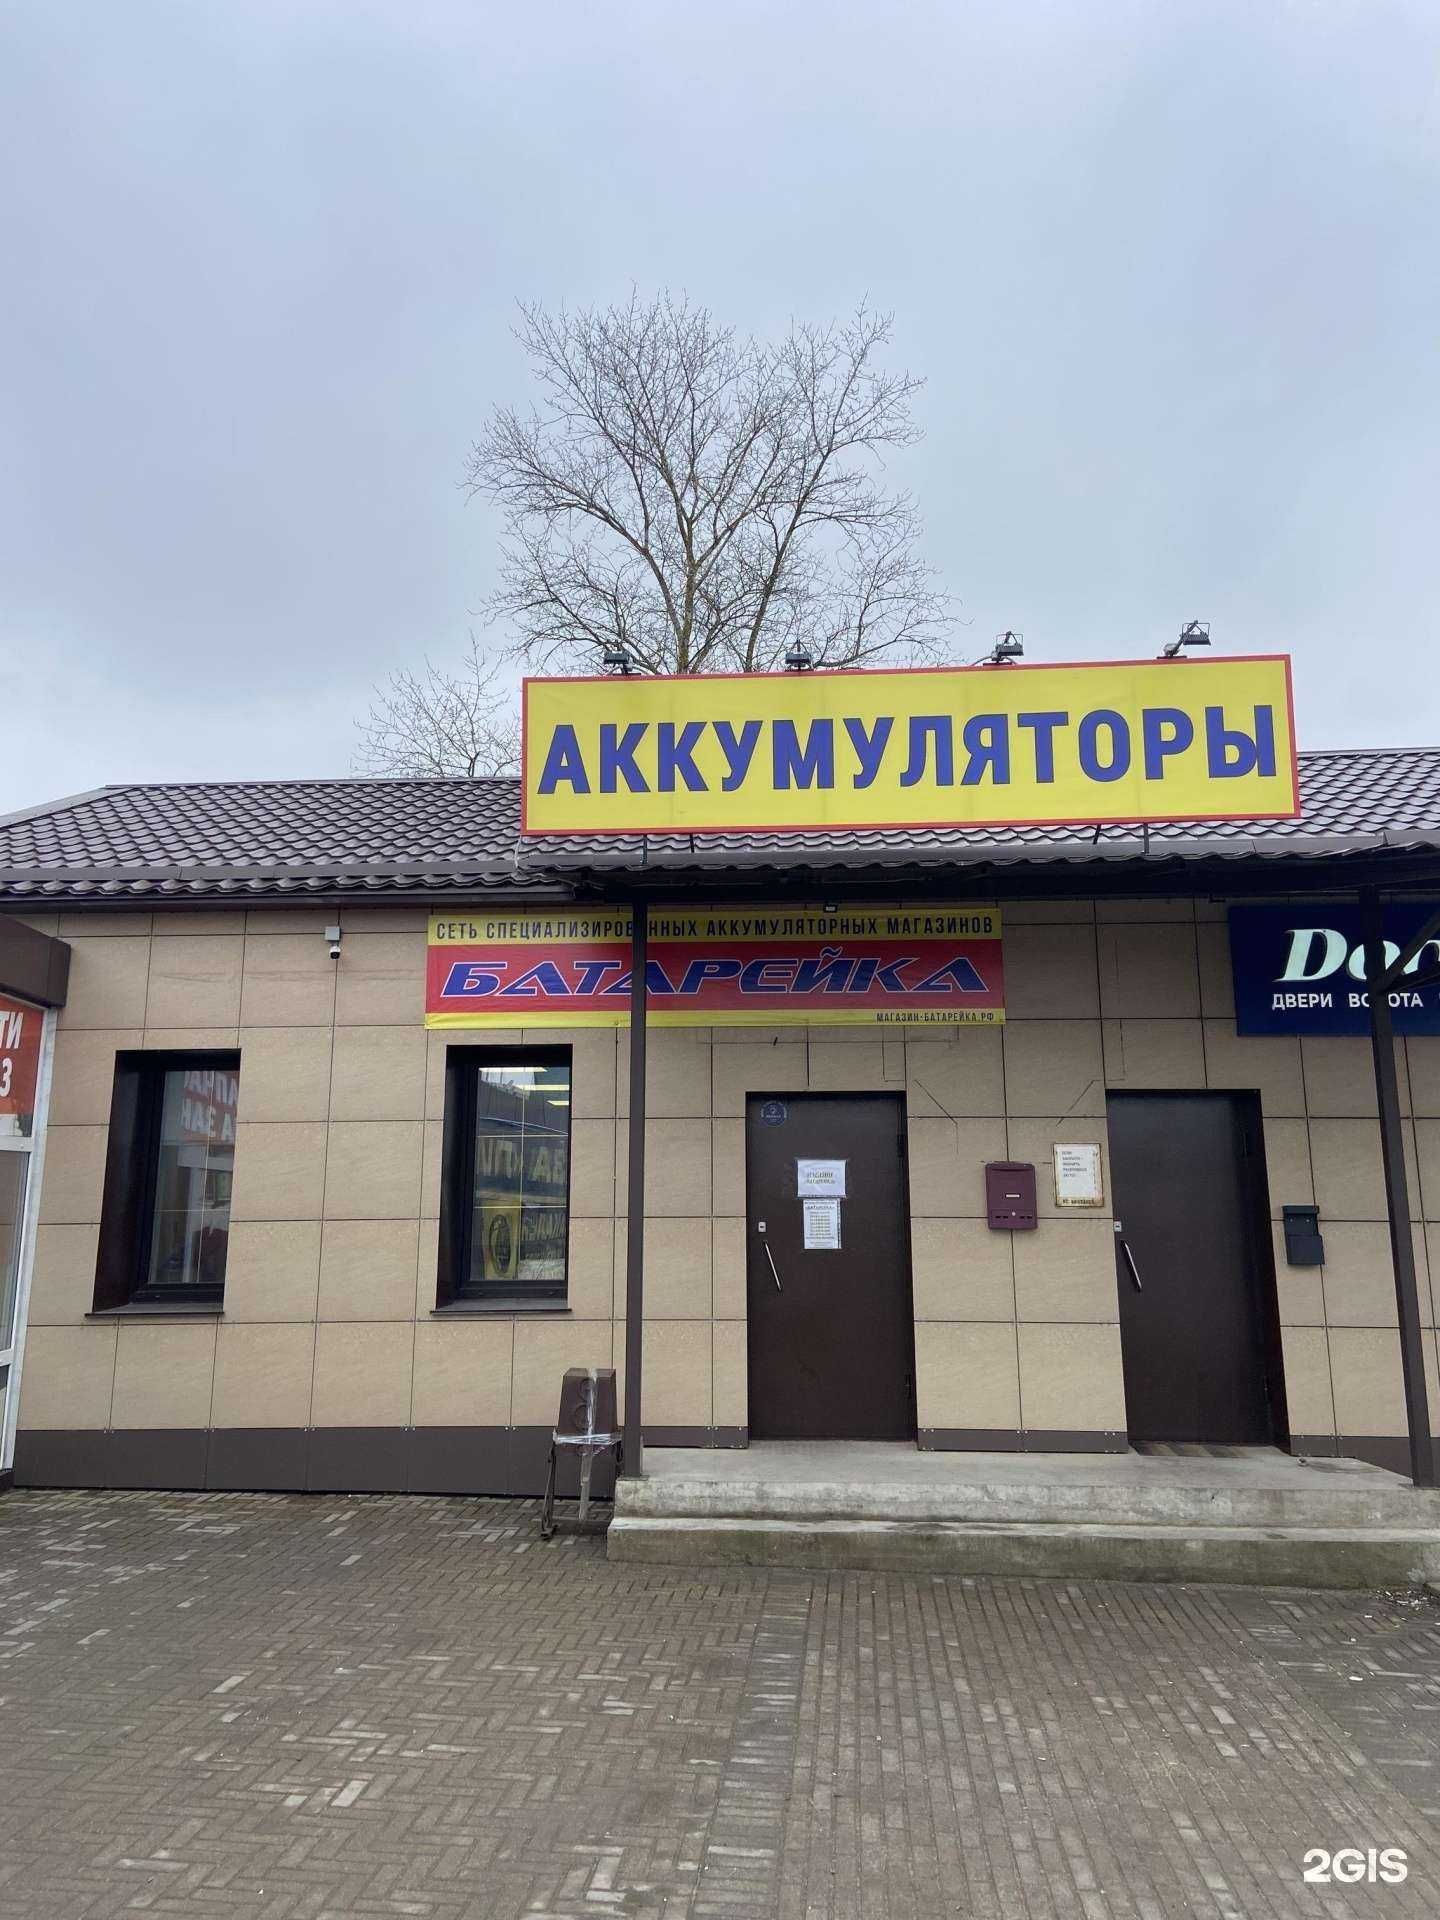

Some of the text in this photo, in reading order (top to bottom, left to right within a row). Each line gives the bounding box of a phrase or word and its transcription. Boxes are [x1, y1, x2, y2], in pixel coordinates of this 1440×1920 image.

[537, 704, 1277, 795] АККУМУЛЯТОРЫ
[436, 916, 993, 941] СЕТЬ СПЕЦИАЛИЗИРОВННЫХ АККУМУЛЯТОРНЫХ МАГАЗИНОВ
[440, 946, 990, 998] БАТАРЕЙКА
[1272, 992, 1424, 1010] ДВЕРИ ВООТА
